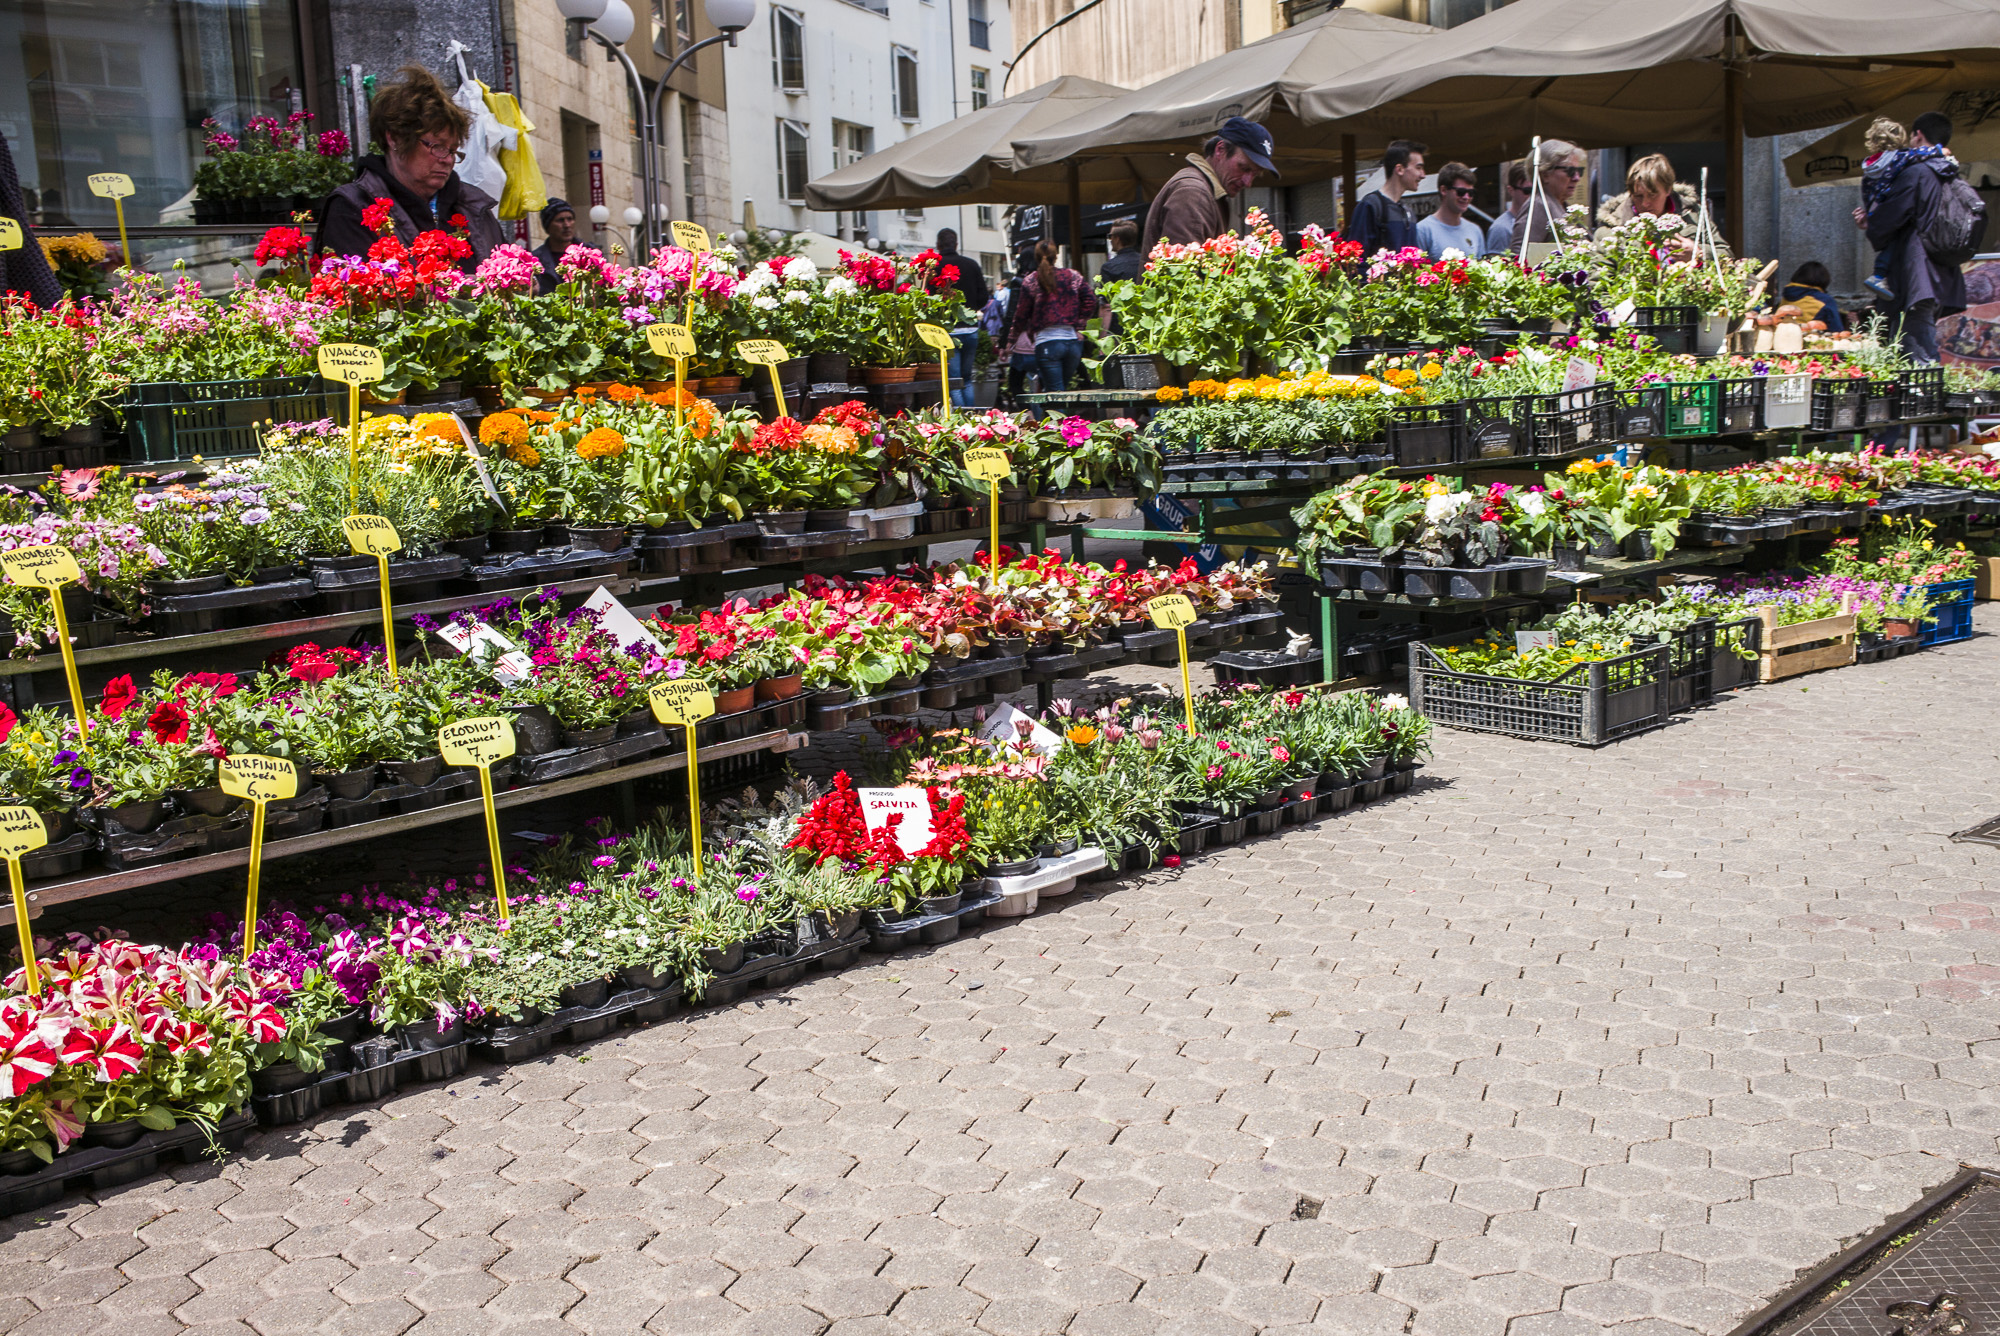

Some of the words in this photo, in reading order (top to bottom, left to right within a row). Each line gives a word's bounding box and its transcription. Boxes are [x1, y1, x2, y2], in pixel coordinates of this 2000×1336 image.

[650, 327, 685, 337] NEVEN
[345, 517, 390, 531] VRBENA
[366, 534, 393, 556] 6,00
[35, 569, 69, 584] 6,00
[674, 706, 701, 723] 7,00
[443, 720, 501, 740] ERODIUM
[467, 745, 501, 763] 7,00
[247, 780, 278, 800] 6,00
[870, 800, 918, 809] SALVIJA
